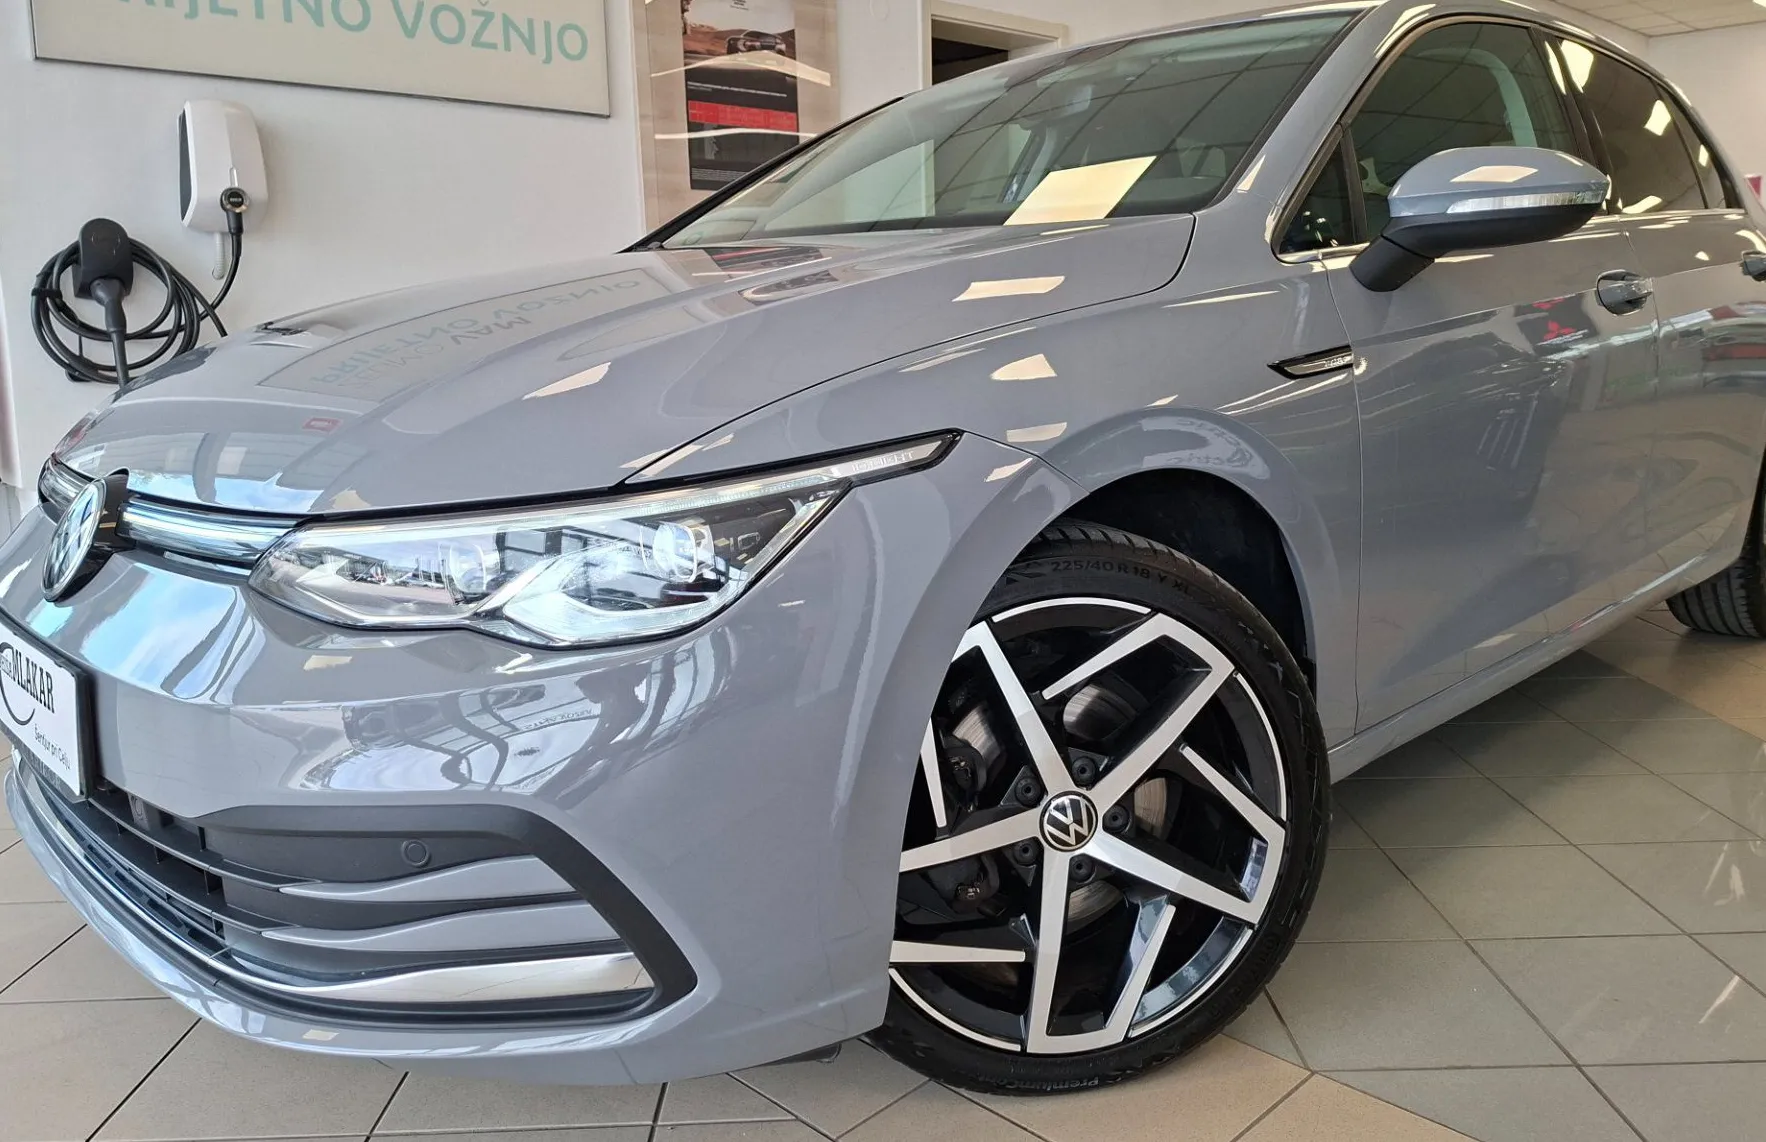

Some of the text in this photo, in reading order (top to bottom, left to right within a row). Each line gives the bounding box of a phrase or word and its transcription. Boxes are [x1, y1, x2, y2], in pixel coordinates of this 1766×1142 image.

[391, 0, 589, 64] VOŽNJO
[1051, 560, 1114, 572] 225/40
[12, 649, 55, 714] MLAKAR
